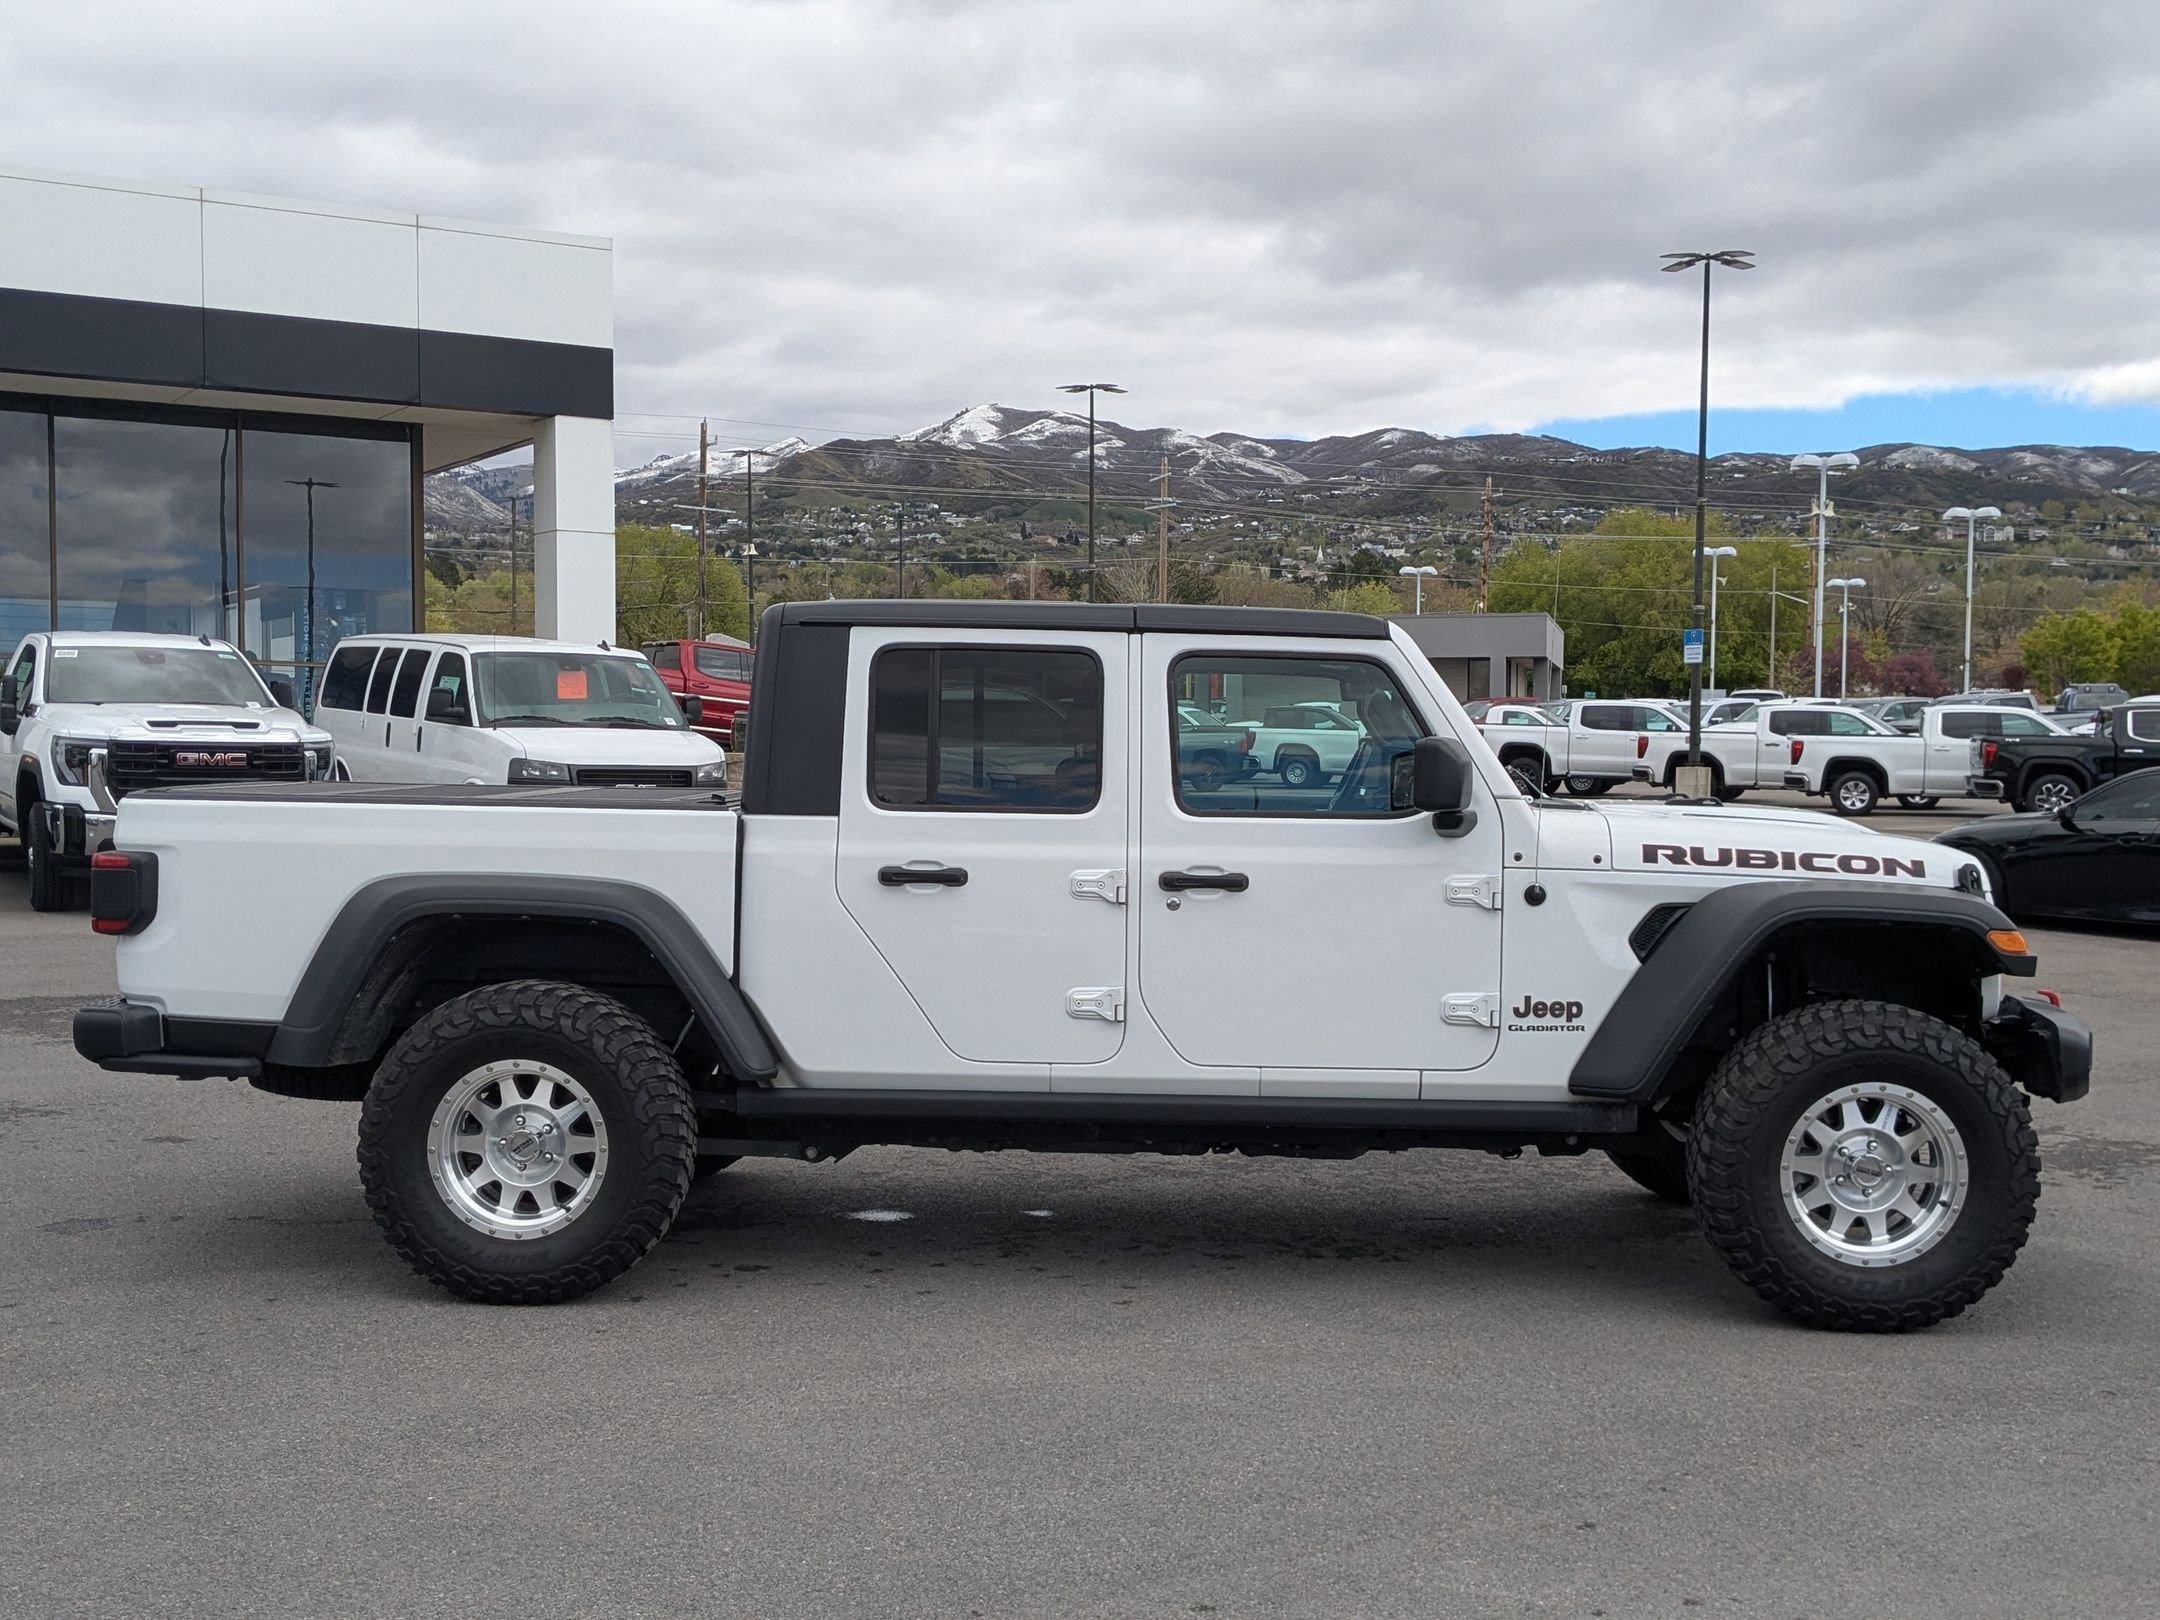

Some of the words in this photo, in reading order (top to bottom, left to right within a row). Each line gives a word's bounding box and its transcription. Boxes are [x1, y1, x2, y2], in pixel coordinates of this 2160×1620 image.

[176, 752, 247, 766] GMC
[1642, 843, 1926, 878] RUBICON
[1512, 995, 1583, 1023] Jeep
[1508, 1024, 1586, 1032] GLADIATOR
